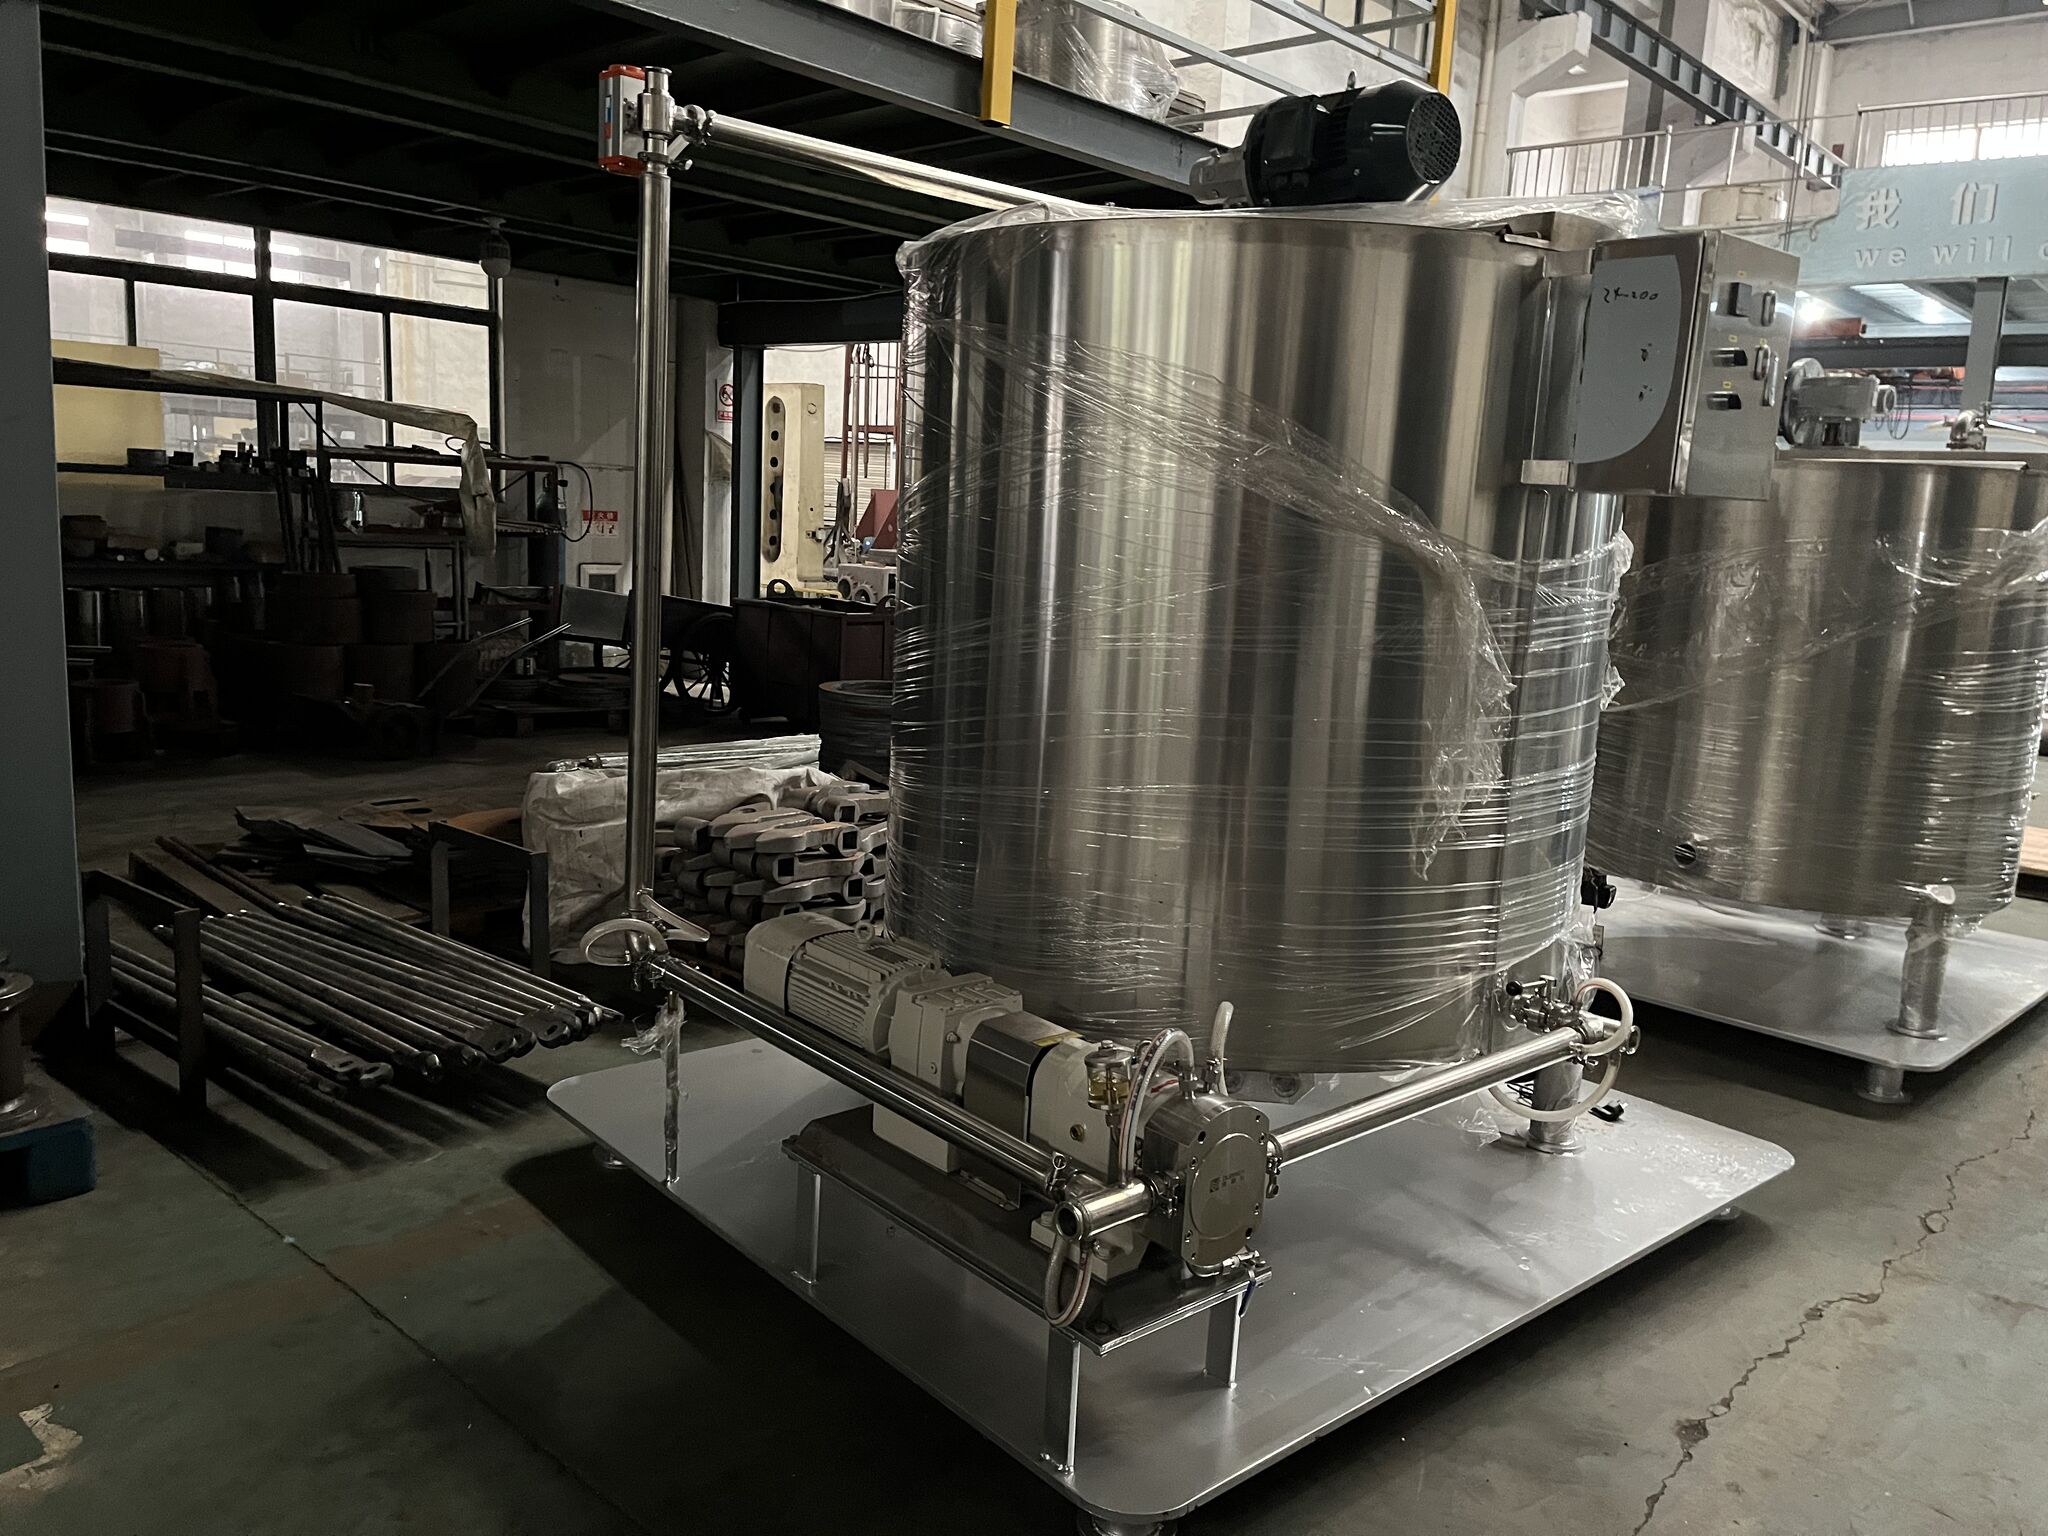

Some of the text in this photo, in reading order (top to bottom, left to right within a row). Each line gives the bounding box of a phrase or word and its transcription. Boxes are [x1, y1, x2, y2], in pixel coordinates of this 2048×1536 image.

[1855, 182, 1998, 230] 我们
[1855, 247, 1907, 269] we
[1932, 235, 2013, 264] will
